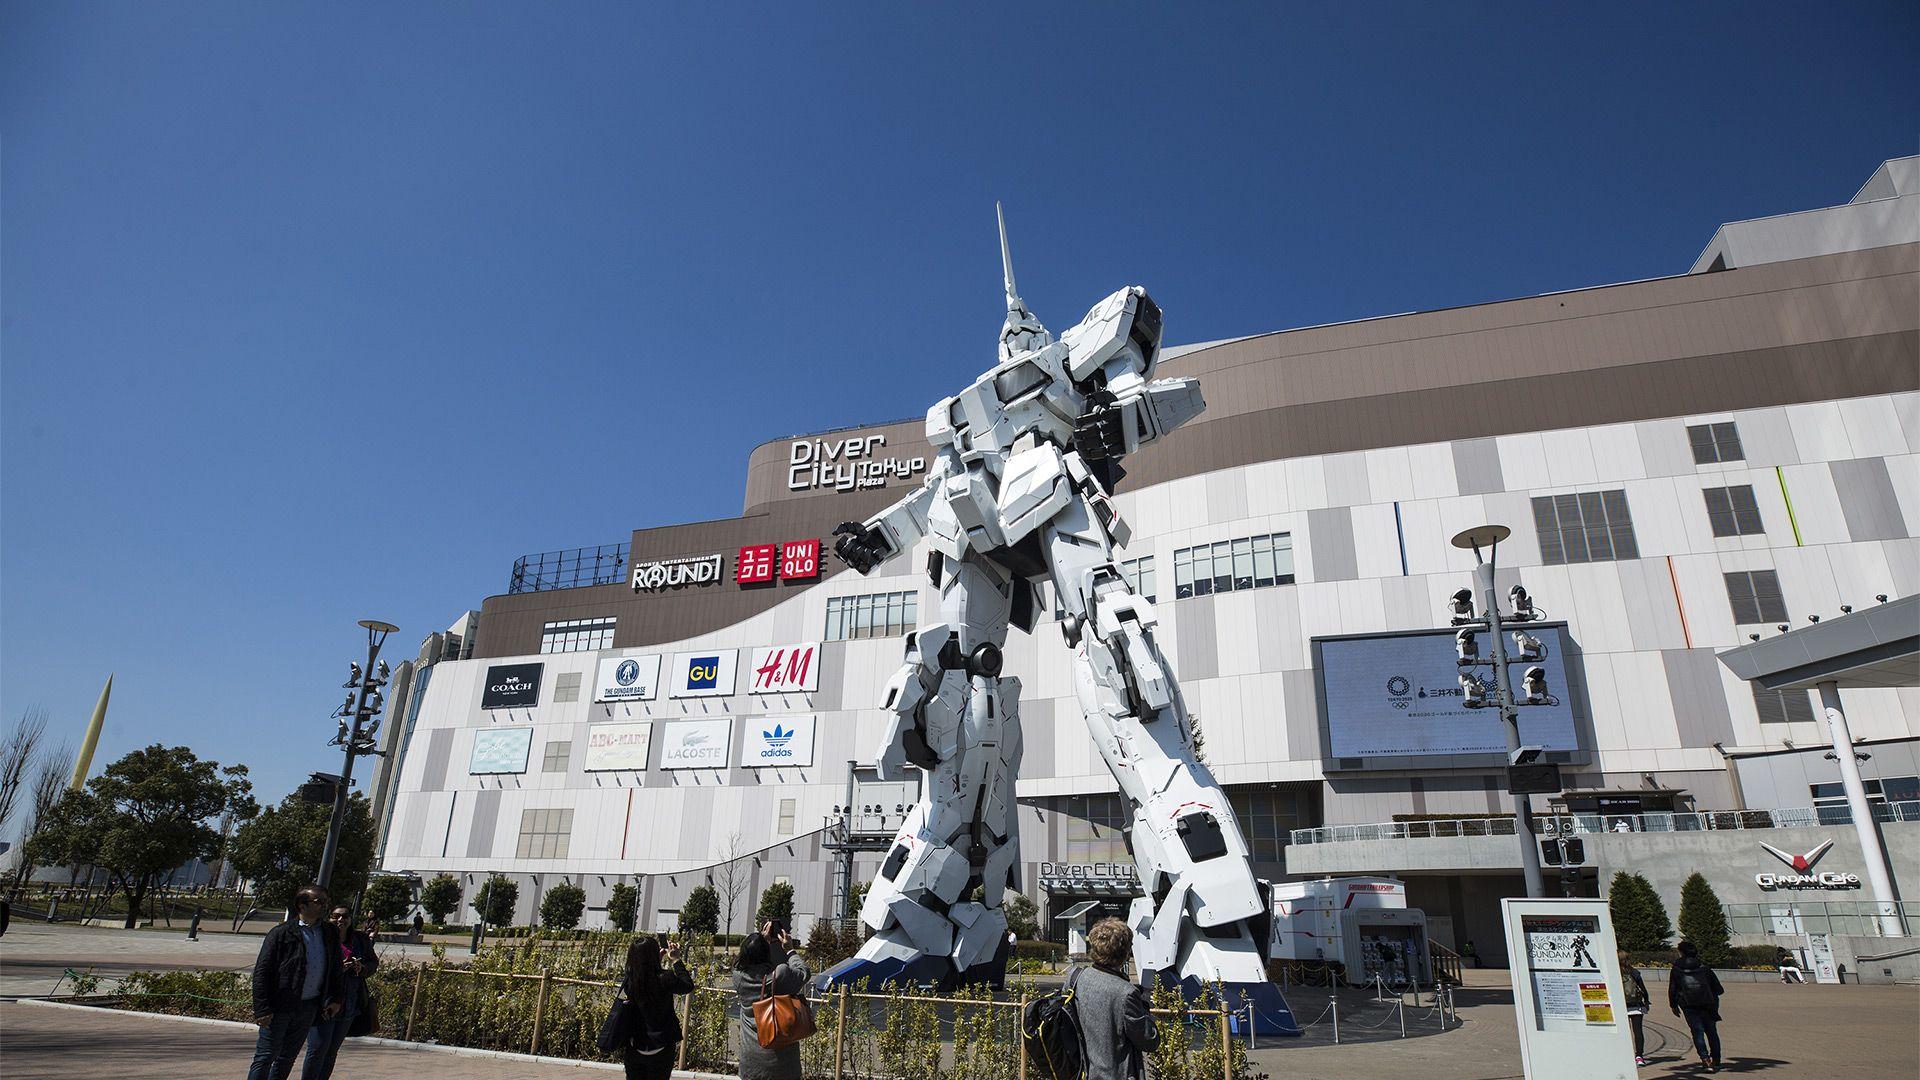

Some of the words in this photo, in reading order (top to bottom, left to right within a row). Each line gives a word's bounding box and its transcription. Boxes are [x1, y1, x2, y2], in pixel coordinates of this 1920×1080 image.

[790, 434, 885, 465] Diver
[788, 461, 856, 491] City
[859, 456, 924, 477] Tokyo
[857, 477, 884, 488] Plaza
[743, 548, 769, 563] ユニ
[786, 544, 812, 559] UNI
[661, 555, 714, 565] ENTERTAINMENT
[631, 554, 721, 589] ROUND1
[740, 563, 769, 579] クロ
[784, 560, 814, 576] QLO
[689, 666, 717, 682] GU
[756, 647, 814, 689] H&M
[491, 683, 532, 692] COACH
[634, 686, 646, 694] BASE
[1430, 688, 1464, 698] 三井不動
[590, 733, 649, 748] ABC-MART
[667, 747, 721, 760] LACOSTE
[760, 747, 793, 758] adidas
[1041, 862, 1134, 879] DiverCity
[1755, 873, 1817, 886] GUNDAM
[1528, 941, 1571, 951] UNICORN
[1528, 950, 1572, 959] GUNDAM
